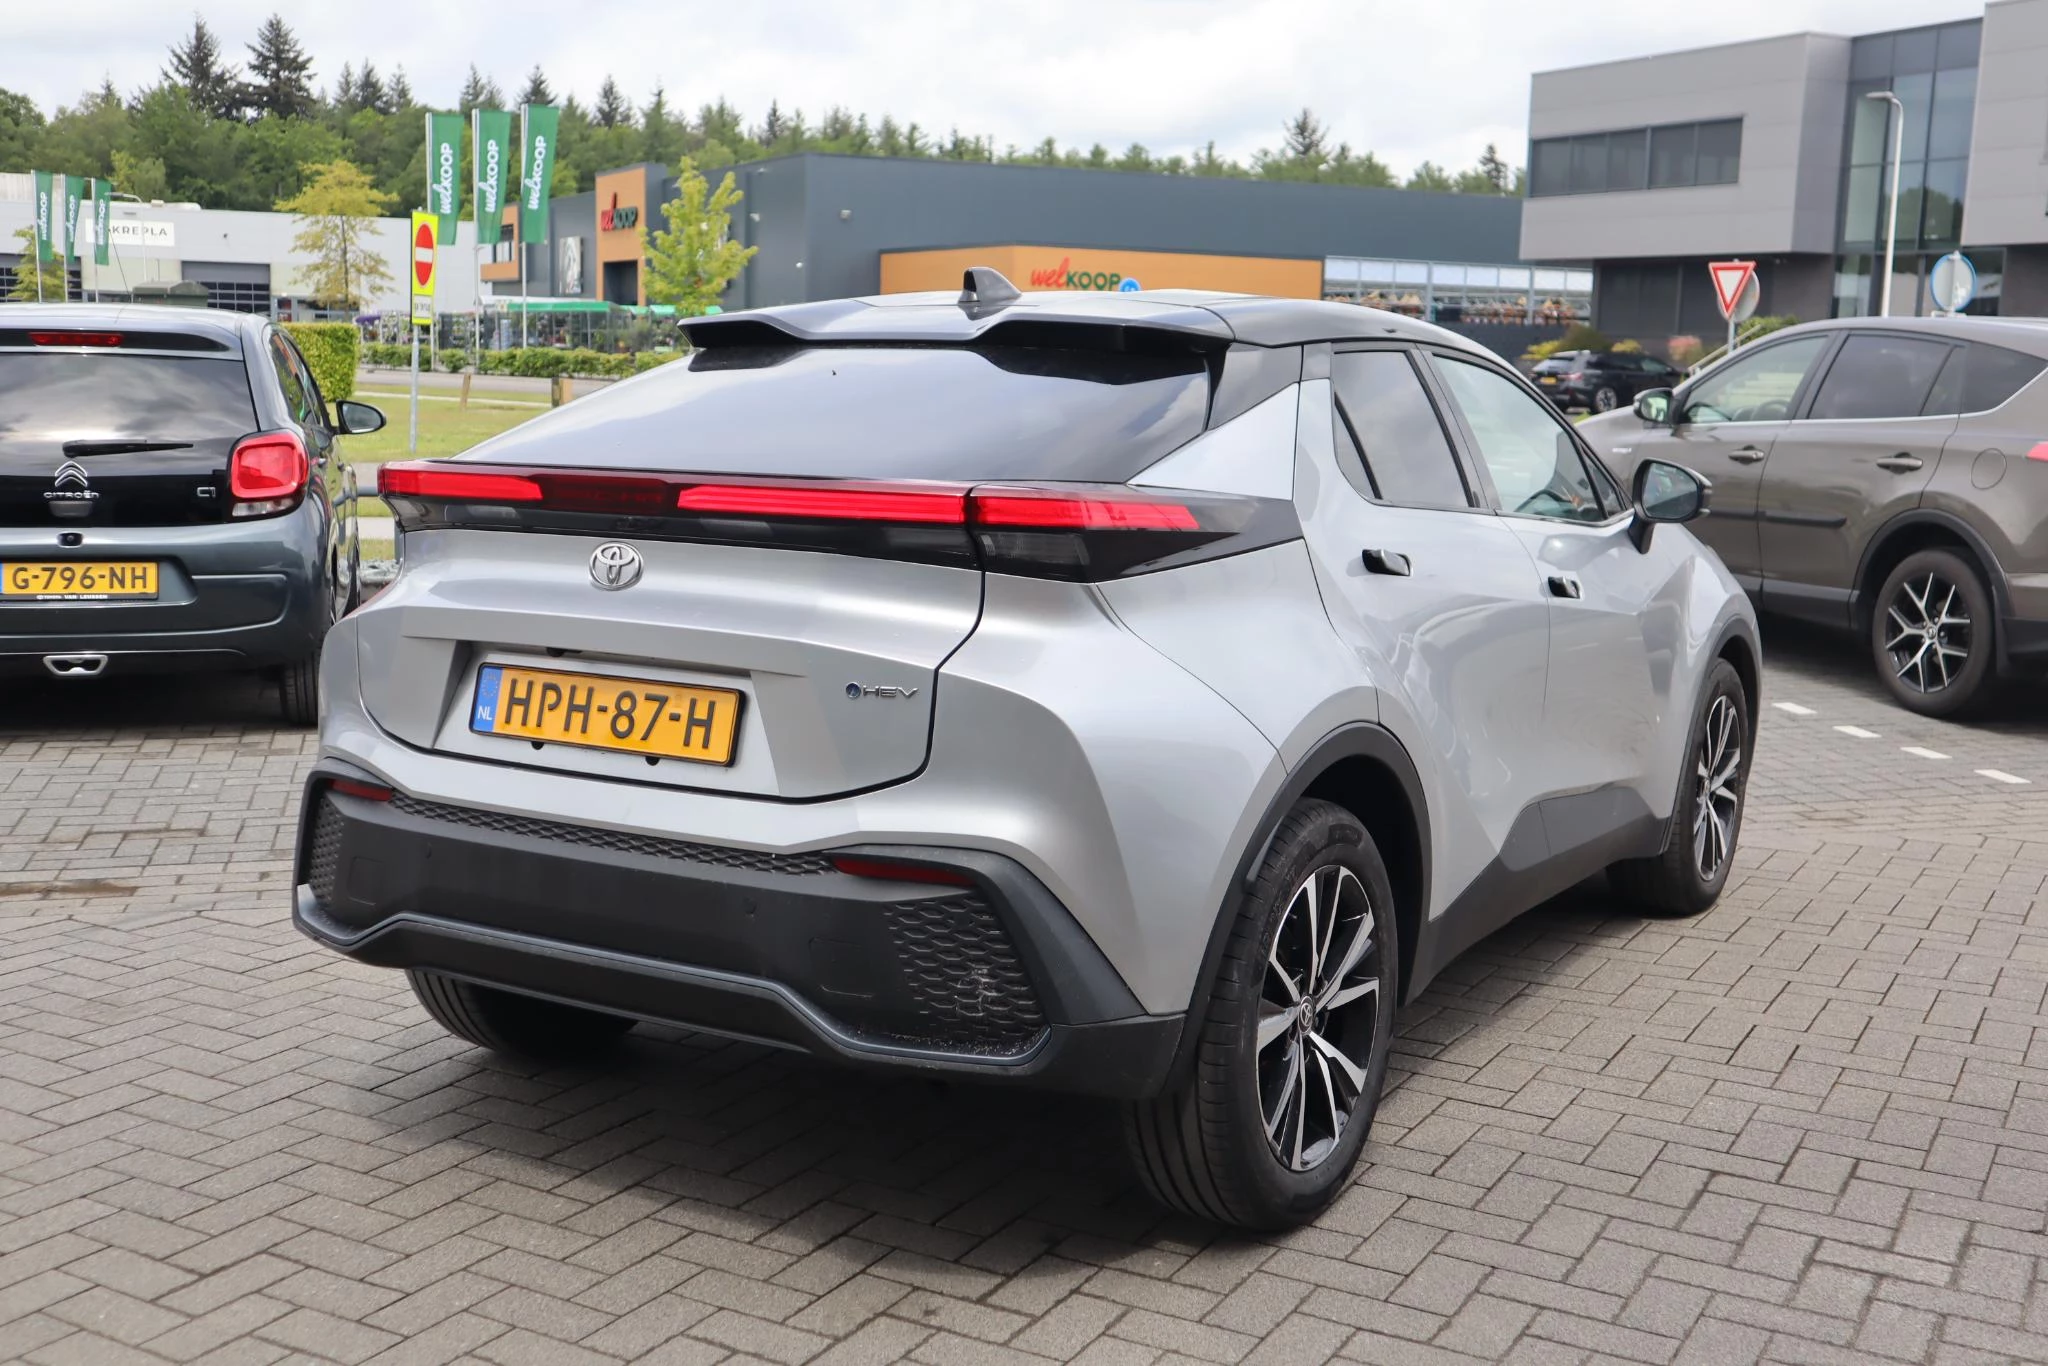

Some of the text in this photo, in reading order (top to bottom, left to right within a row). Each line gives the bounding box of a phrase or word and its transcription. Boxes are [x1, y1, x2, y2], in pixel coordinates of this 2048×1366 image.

[12, 566, 147, 590] G-796-NH
[862, 684, 919, 699] HEV
[477, 709, 492, 721] NL
[504, 678, 716, 750] HPH-87-H
